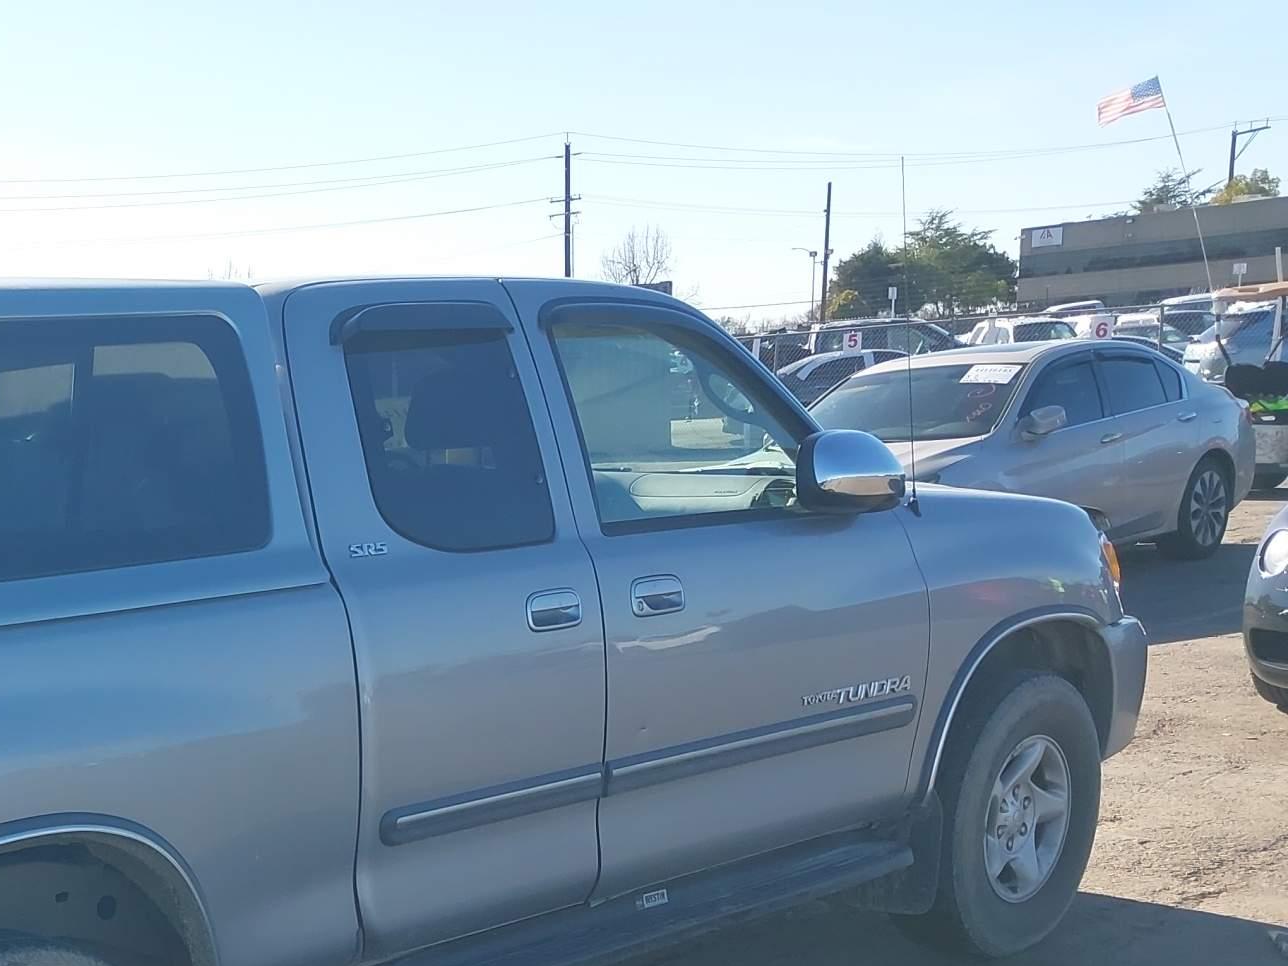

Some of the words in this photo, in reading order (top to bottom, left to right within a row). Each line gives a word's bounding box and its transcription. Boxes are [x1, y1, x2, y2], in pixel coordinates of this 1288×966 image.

[1095, 322, 1108, 338] 6
[847, 334, 858, 348] 5
[349, 542, 388, 557] SR5
[836, 675, 911, 704] TUNDRA
